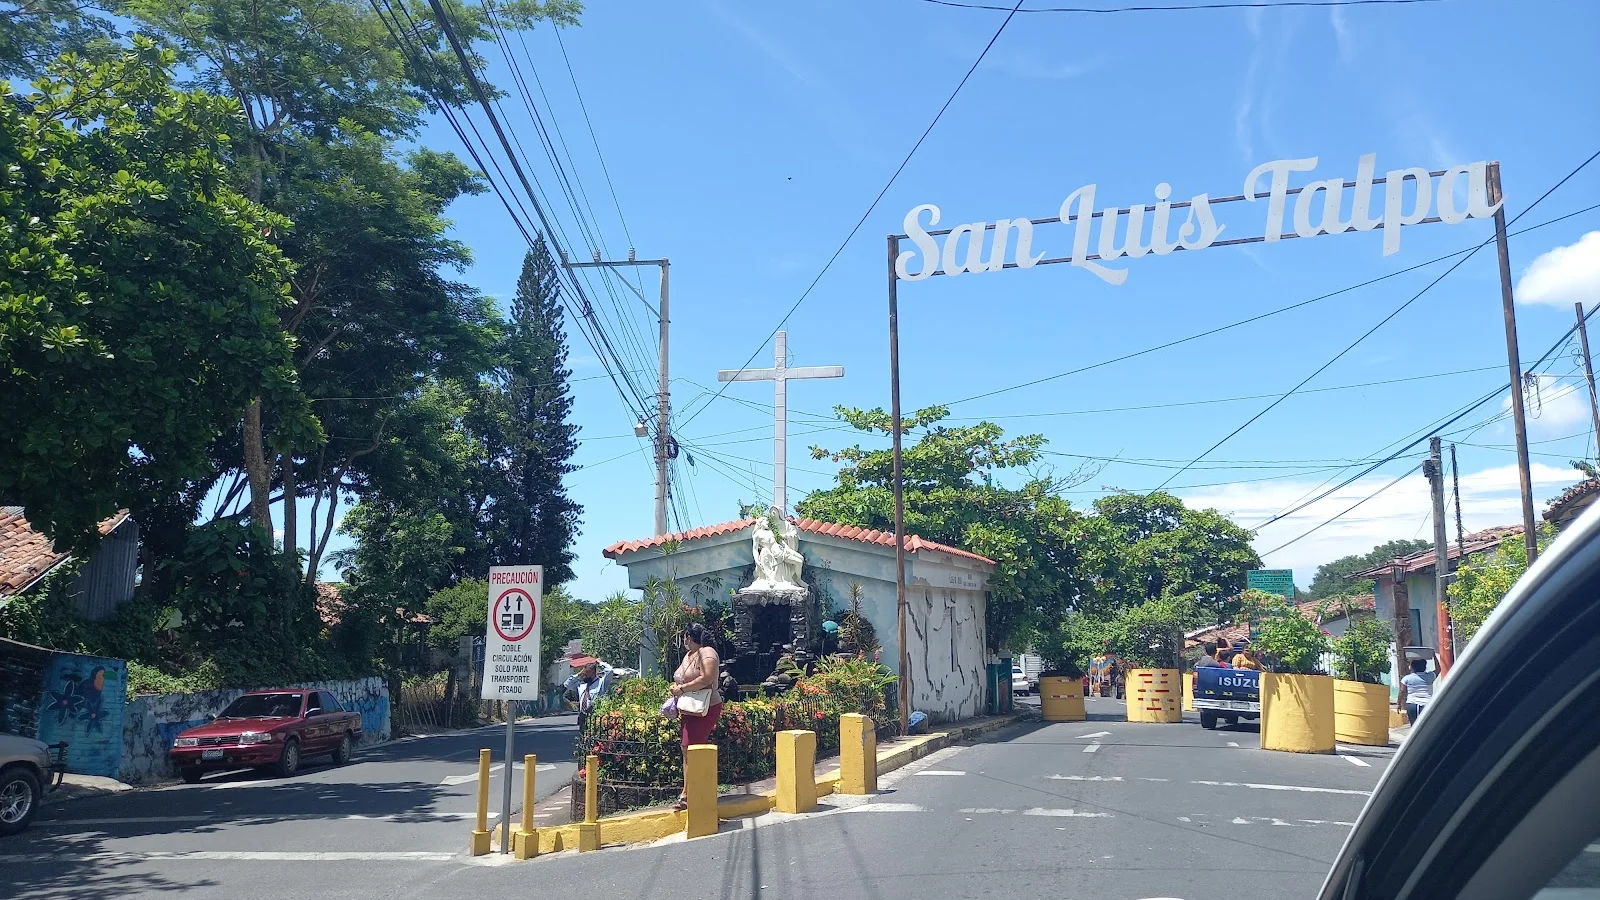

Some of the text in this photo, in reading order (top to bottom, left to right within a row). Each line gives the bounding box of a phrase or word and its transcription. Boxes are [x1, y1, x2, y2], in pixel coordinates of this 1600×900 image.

[895, 152, 1509, 286] San Luis Talpa
[492, 569, 539, 585] PRECAUCIÓN
[501, 644, 522, 652] DOBLE
[492, 653, 532, 663] CIRCULACIÓN
[494, 664, 529, 673] SOLO PARA
[491, 675, 530, 684] TRANSPORTE
[1218, 676, 1259, 689] ISUZU
[498, 685, 523, 694] PESADO
